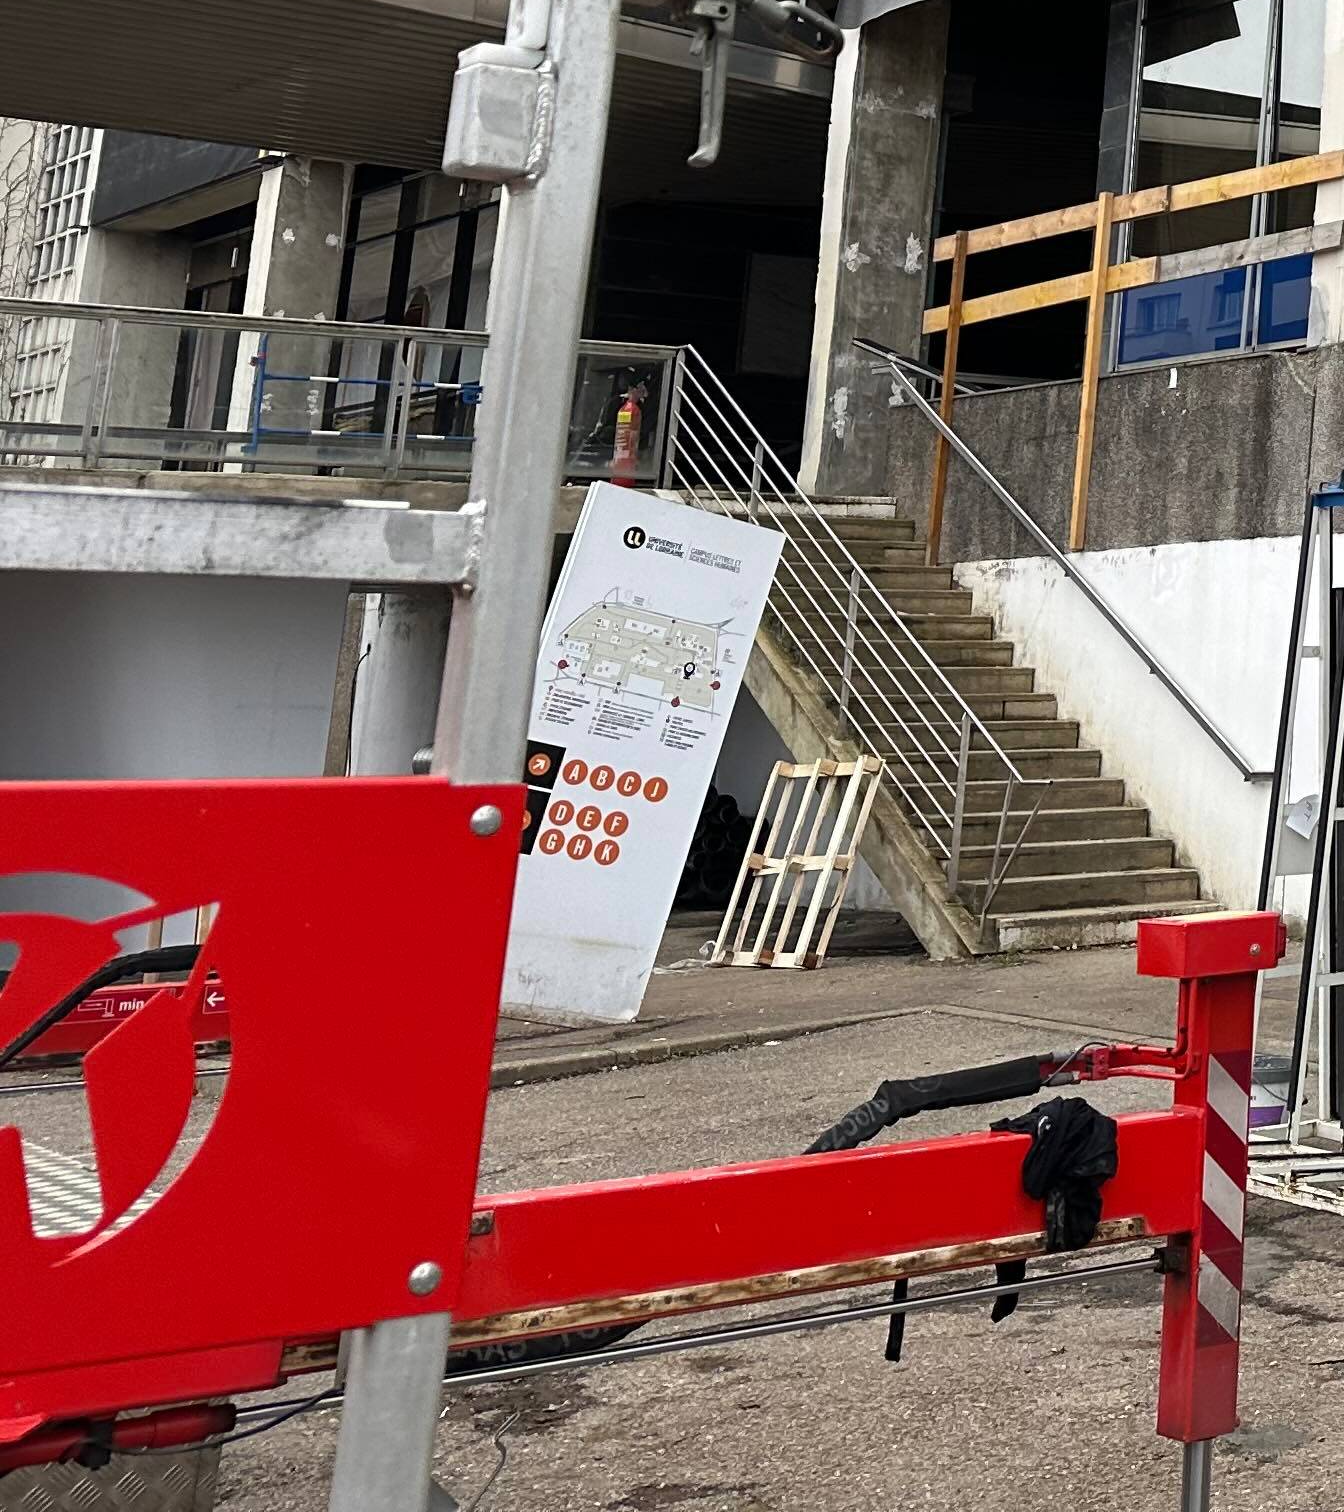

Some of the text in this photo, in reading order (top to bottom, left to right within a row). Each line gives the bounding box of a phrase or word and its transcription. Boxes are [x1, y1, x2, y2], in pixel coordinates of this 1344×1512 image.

[568, 764, 659, 798] A B C J
[555, 805, 622, 832] D E F
[546, 834, 613, 862] G H K
[118, 997, 145, 1012] min
